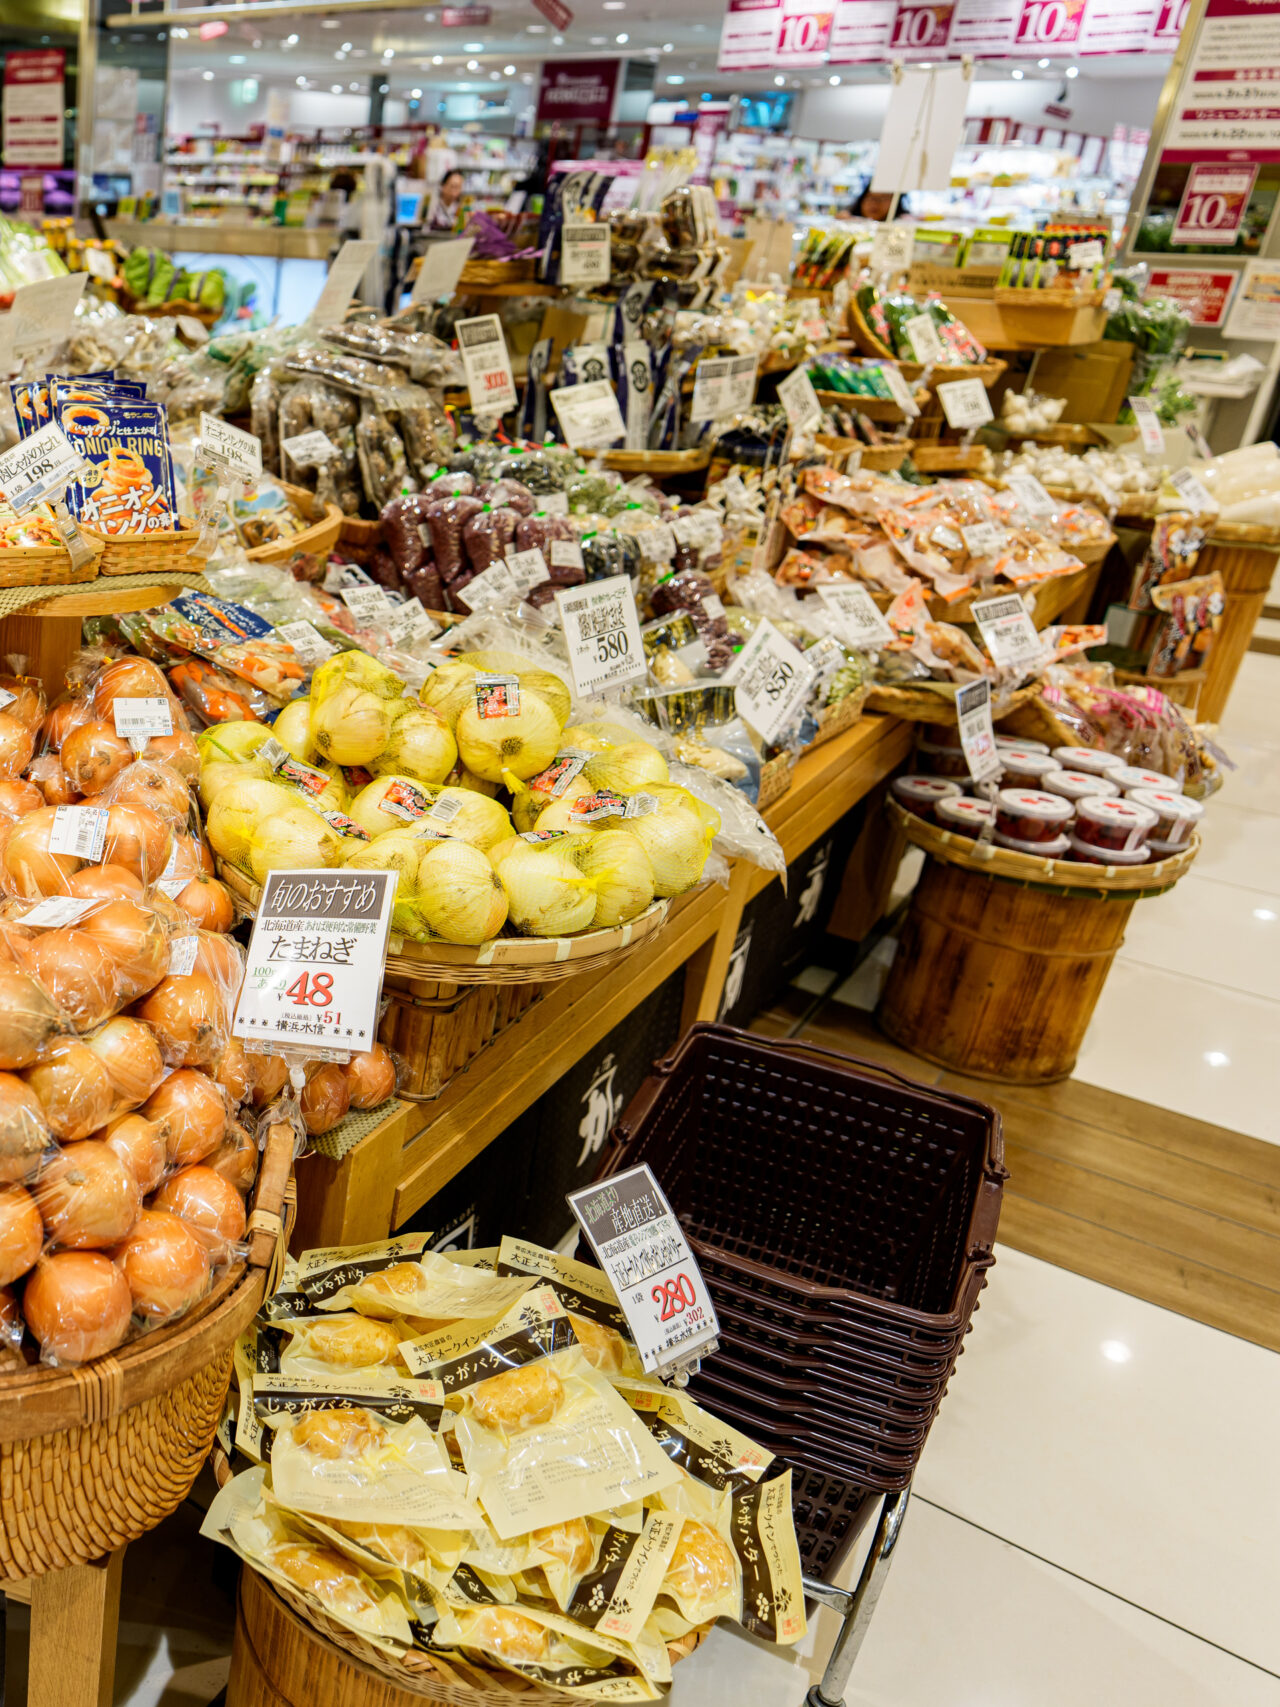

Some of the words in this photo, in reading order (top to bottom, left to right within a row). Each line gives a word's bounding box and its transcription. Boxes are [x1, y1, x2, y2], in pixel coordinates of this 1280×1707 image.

[127, 437, 163, 457] RING
[80, 485, 164, 522] オニオン
[271, 879, 376, 913] 旬のおすすめ
[261, 919, 304, 932] 北海道産
[269, 936, 357, 962] たまねぎ
[275, 1020, 326, 1035] 横浜水信
[585, 1185, 619, 1224] 北海道より
[602, 1236, 631, 1259] 北海道産
[633, 1291, 644, 1304] 1袋
[416, 1322, 510, 1366] 大正メークインでつくった
[429, 1347, 519, 1385] ゃがバター
[738, 1494, 759, 1581] じゃがバター
